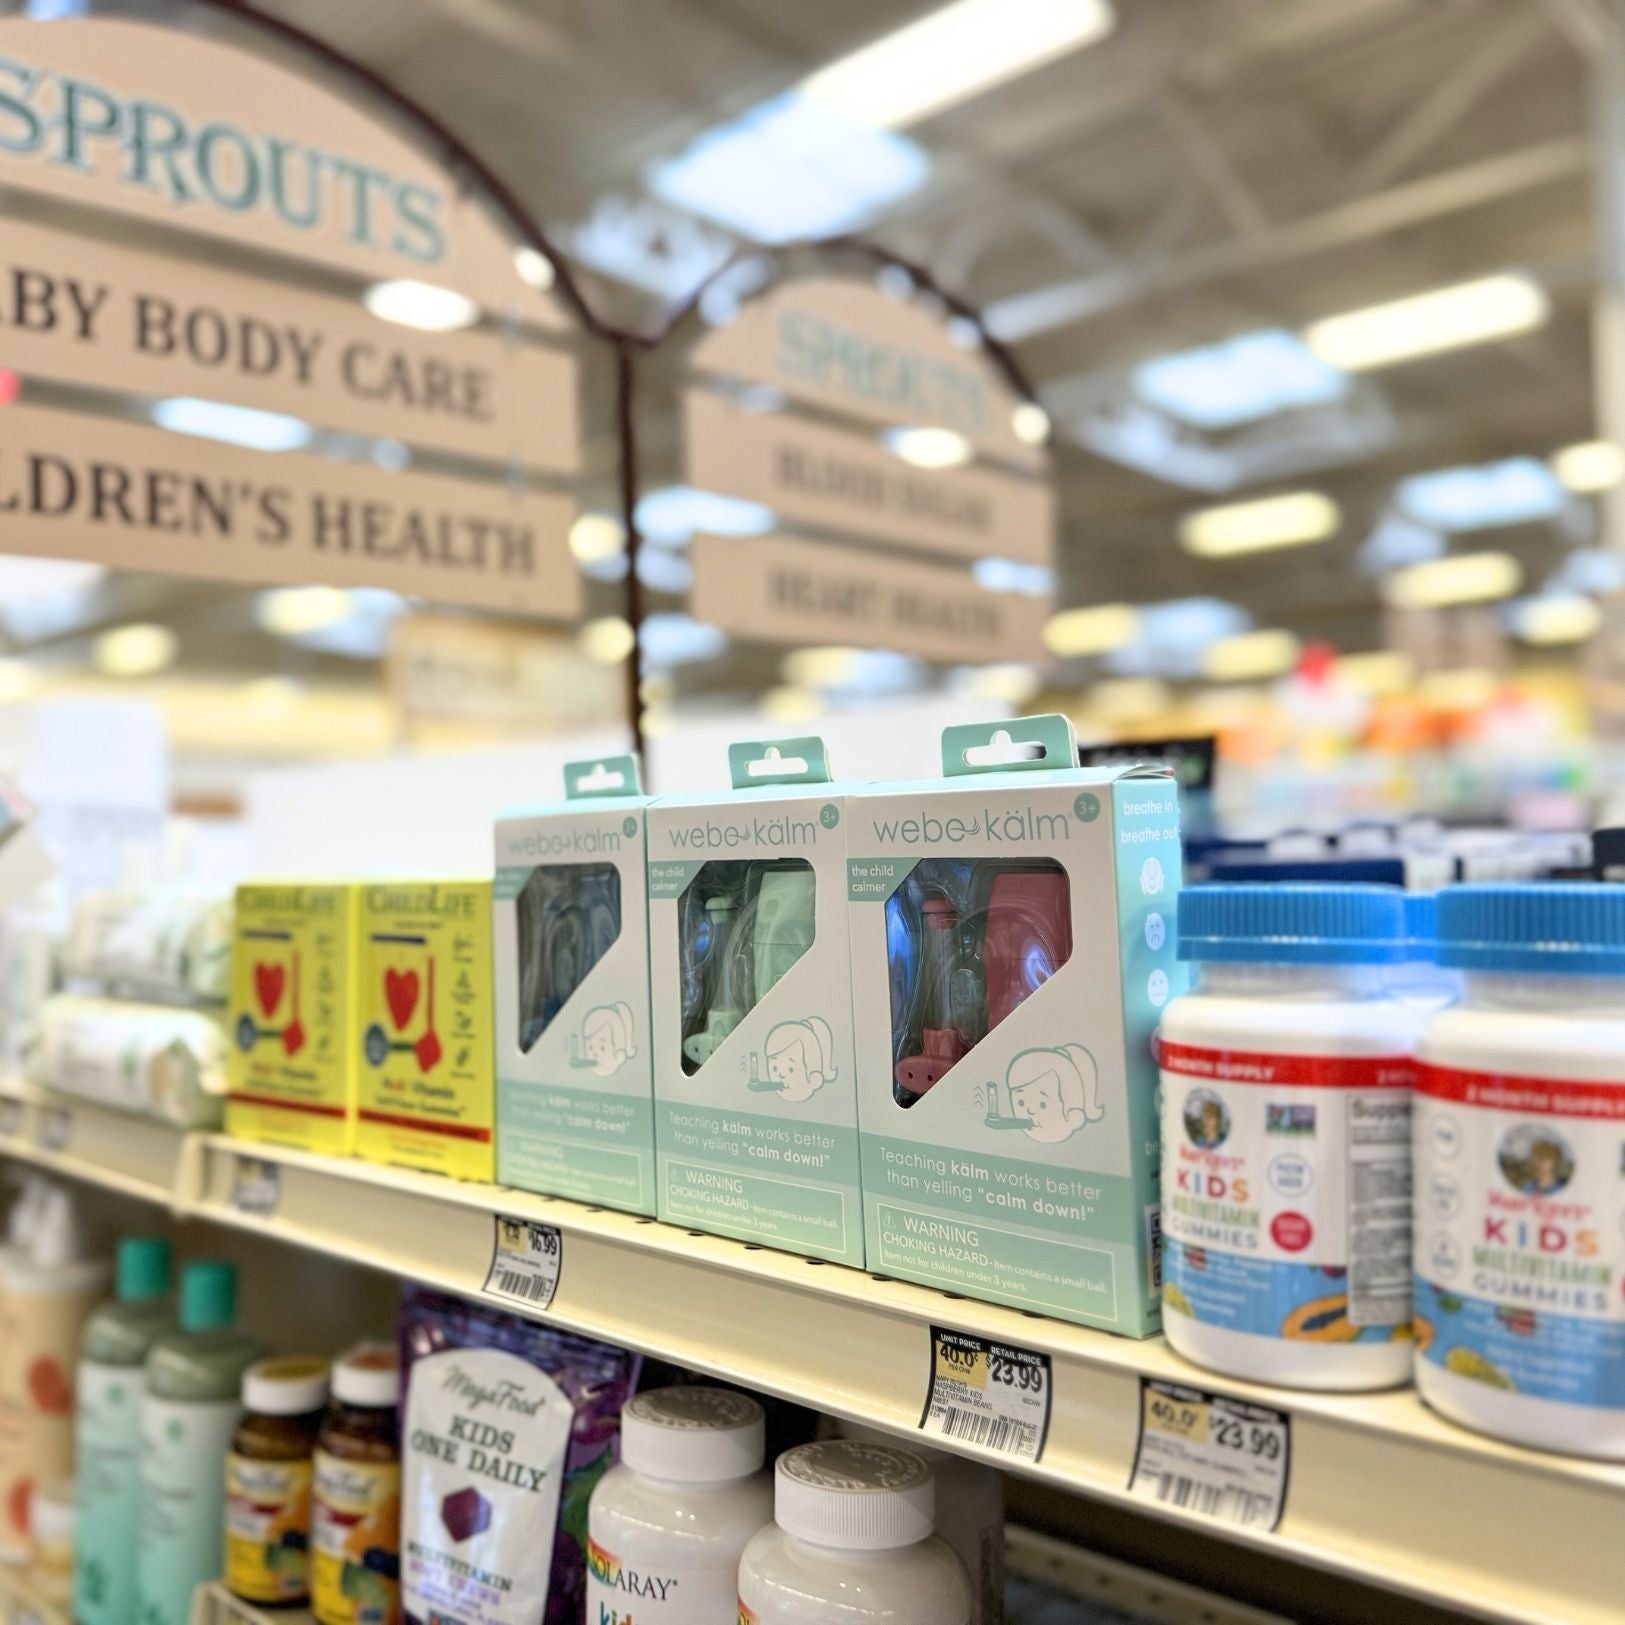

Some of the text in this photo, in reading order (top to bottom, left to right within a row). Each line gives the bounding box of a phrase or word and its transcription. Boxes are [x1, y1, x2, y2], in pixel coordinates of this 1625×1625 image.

[0, 58, 448, 266] SPROUTS
[0, 267, 493, 423] BY BODY CARE
[0, 454, 536, 579] DREN'S HEALTH
[822, 810, 837, 822] 3+
[1079, 801, 1096, 814] 3+
[1123, 799, 1173, 815] breathe in
[669, 817, 817, 848] webe kälm
[873, 808, 1070, 843] webe kälm
[1120, 827, 1178, 844] breathe out
[652, 865, 685, 878] the child
[852, 865, 894, 877] the child
[652, 881, 678, 893] calmer
[852, 881, 886, 893] calmer
[669, 1110, 835, 1149] Teaching kälm works better
[674, 1131, 698, 1144] than
[701, 1136, 739, 1156] yelling
[686, 1169, 743, 1193] WARNING
[880, 1147, 1102, 1200] Teaching kälm works better
[887, 1170, 919, 1187] than
[924, 1179, 972, 1201] yelling
[1177, 1168, 1249, 1203] KIDS
[670, 1184, 710, 1203] CHOKING
[712, 1193, 749, 1210] HAZARD
[904, 1215, 979, 1247] WARNING
[1171, 1217, 1259, 1249] GUMMIES
[1484, 1216, 1600, 1258] KIDS
[884, 1232, 936, 1255] CHOKING
[938, 1245, 988, 1267] HAZARD
[1014, 1265, 1052, 1281] contains
[1060, 1275, 1086, 1288] small
[903, 1254, 916, 1264] not
[916, 1256, 929, 1268] for
[930, 1260, 964, 1276] children
[967, 1269, 992, 1283] under
[994, 1275, 1000, 1285] 3
[1472, 1271, 1608, 1311] GUMMIES
[940, 1333, 1041, 1366] UNIT PRICE RETAIL PRICE
[934, 1388, 972, 1405] MULTIVITAMIN
[936, 1380, 983, 1399] RASPBERRY KIDS
[450, 1415, 515, 1455] KIDS
[411, 1429, 549, 1494] ONE DAILY
